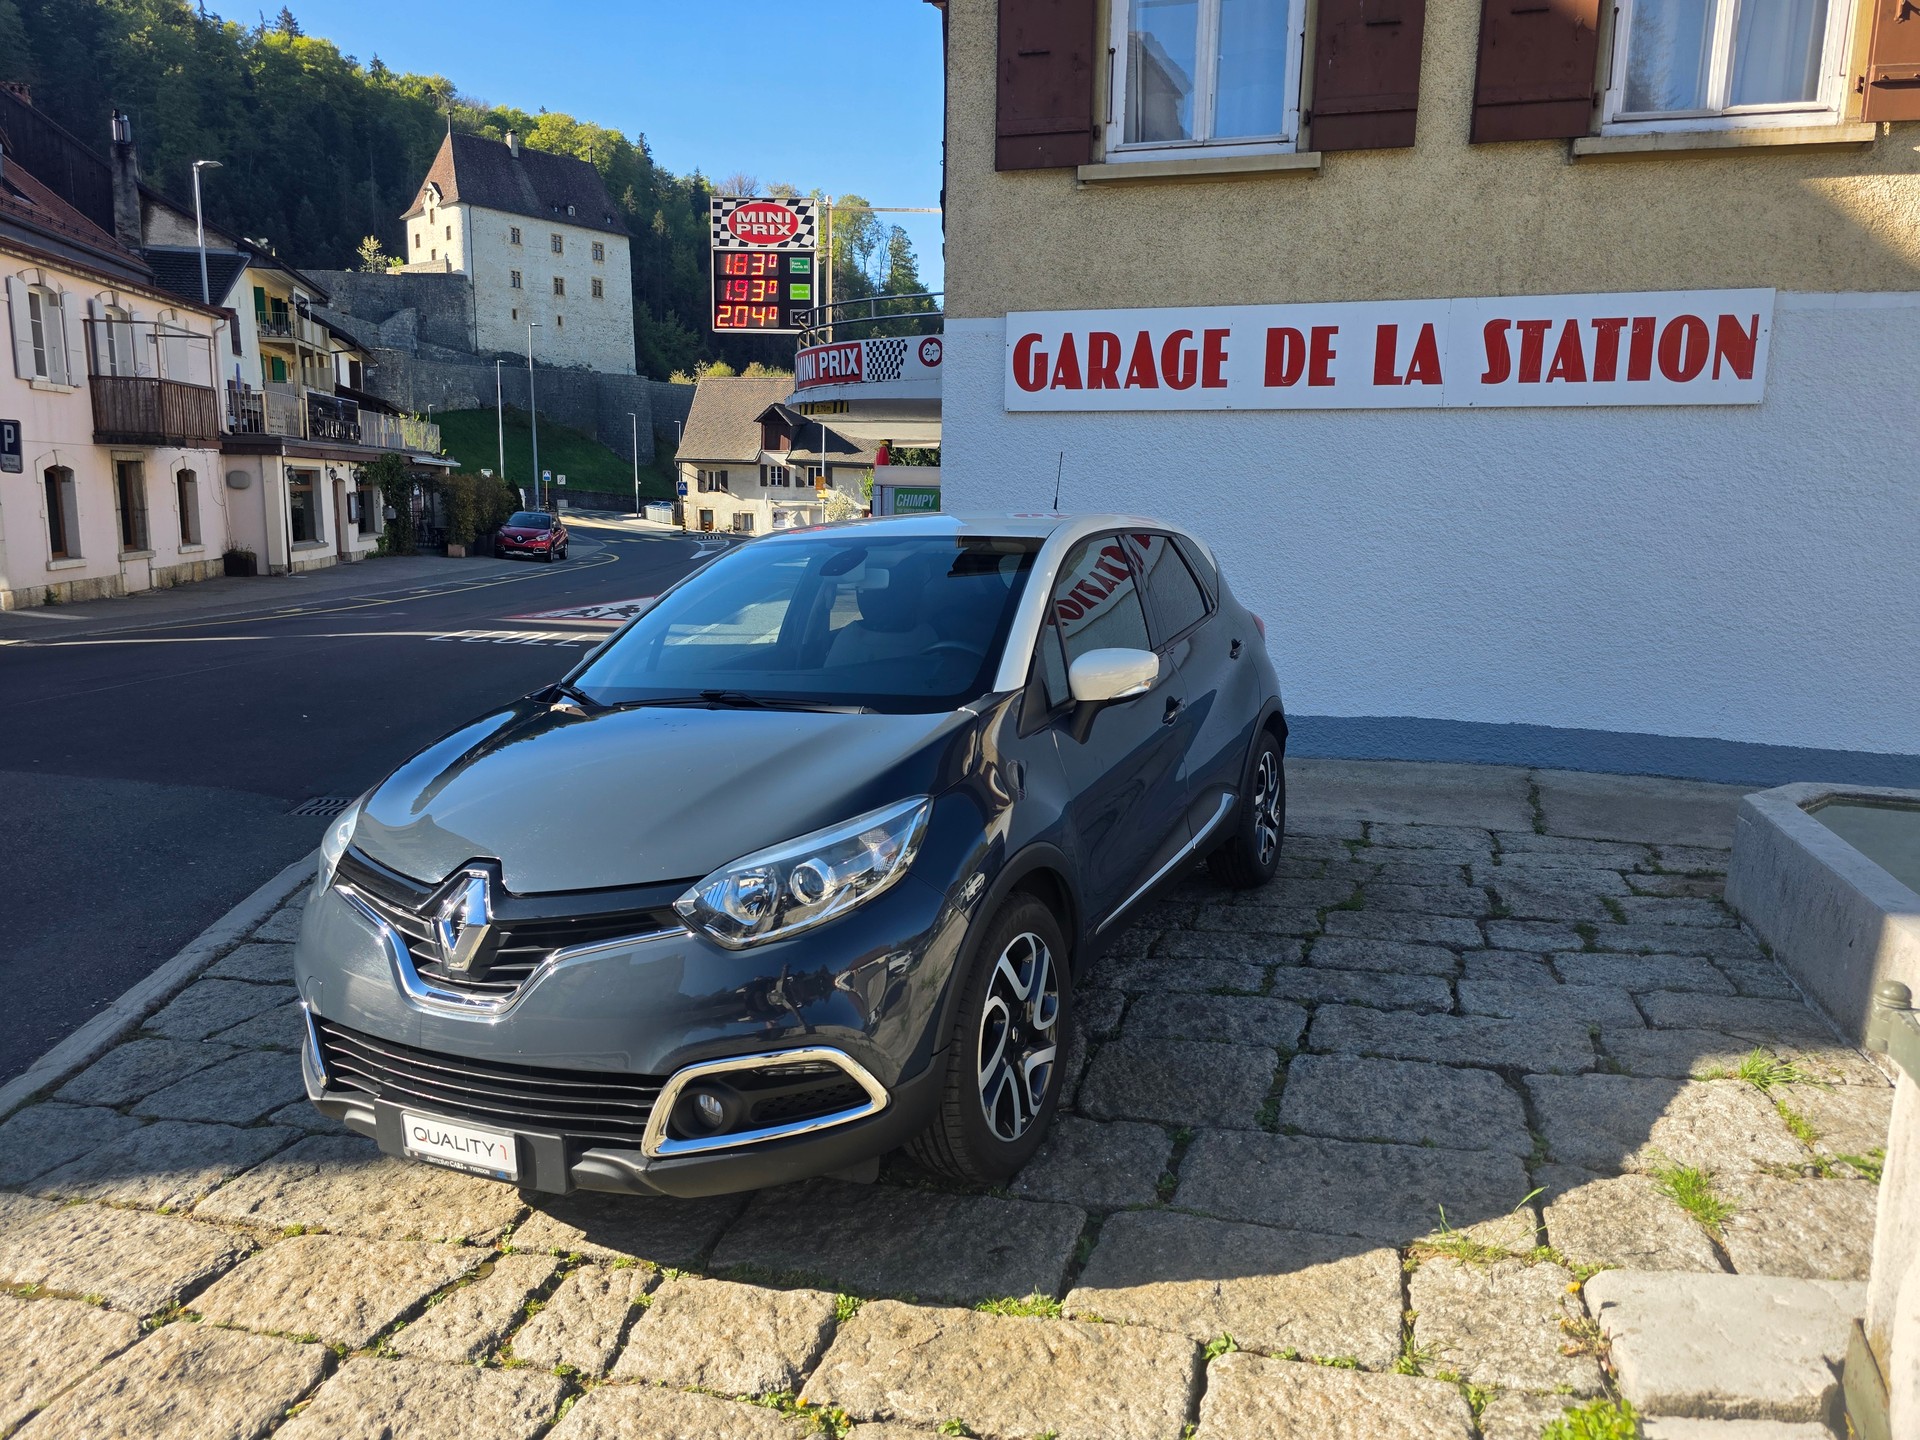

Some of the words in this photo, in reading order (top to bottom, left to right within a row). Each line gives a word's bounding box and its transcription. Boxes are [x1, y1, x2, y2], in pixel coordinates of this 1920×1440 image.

[736, 211, 791, 223] MINI
[736, 224, 792, 236] PRIX
[797, 353, 816, 382] MINI
[819, 347, 860, 378] PRIX
[1012, 328, 1229, 393] GARAGE
[1264, 326, 1337, 388] DE
[1372, 323, 1442, 386] LA
[1480, 313, 1760, 385] STATION
[3, 424, 15, 452] P
[896, 494, 935, 506] CHIMPY
[413, 1127, 495, 1156] QUALITY
